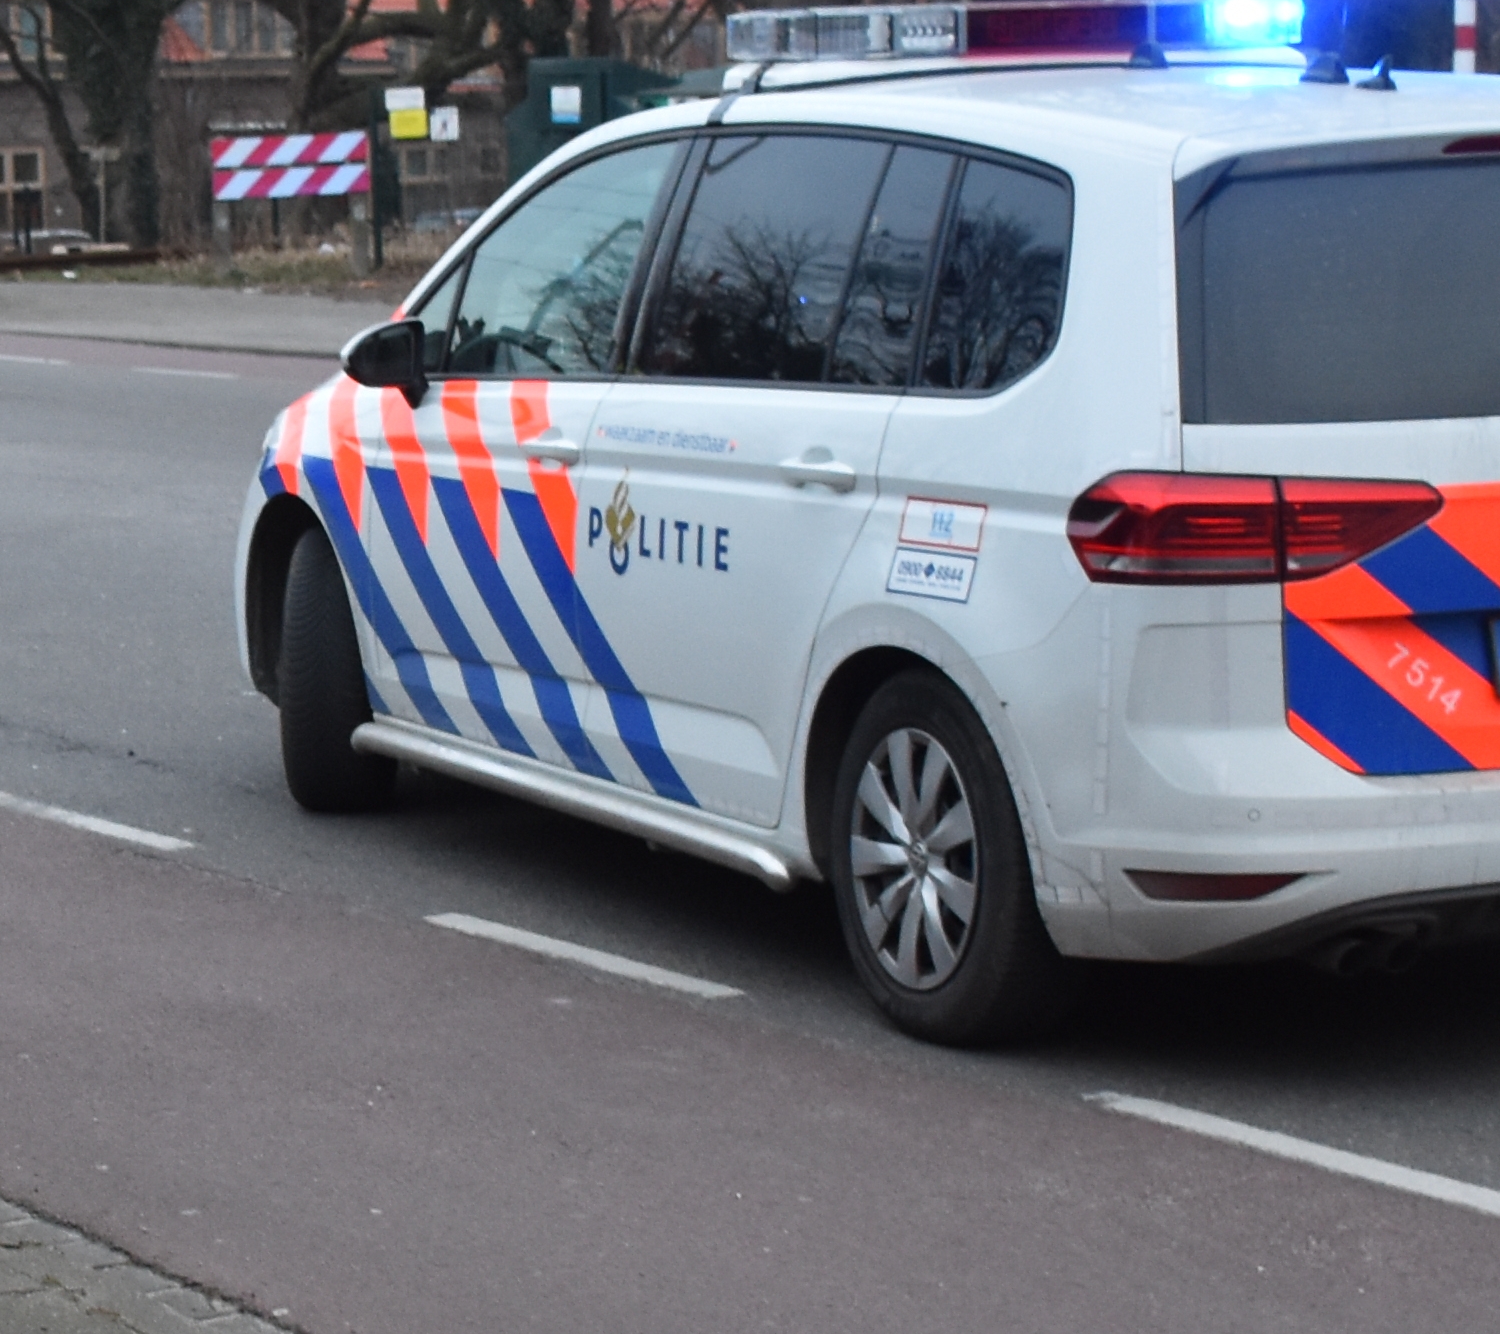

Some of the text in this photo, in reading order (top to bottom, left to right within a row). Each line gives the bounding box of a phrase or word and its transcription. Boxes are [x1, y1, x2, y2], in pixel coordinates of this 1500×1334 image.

[588, 505, 730, 576] POLITIE
[898, 560, 964, 582] 0900 8844
[1386, 640, 1464, 715] 7514
